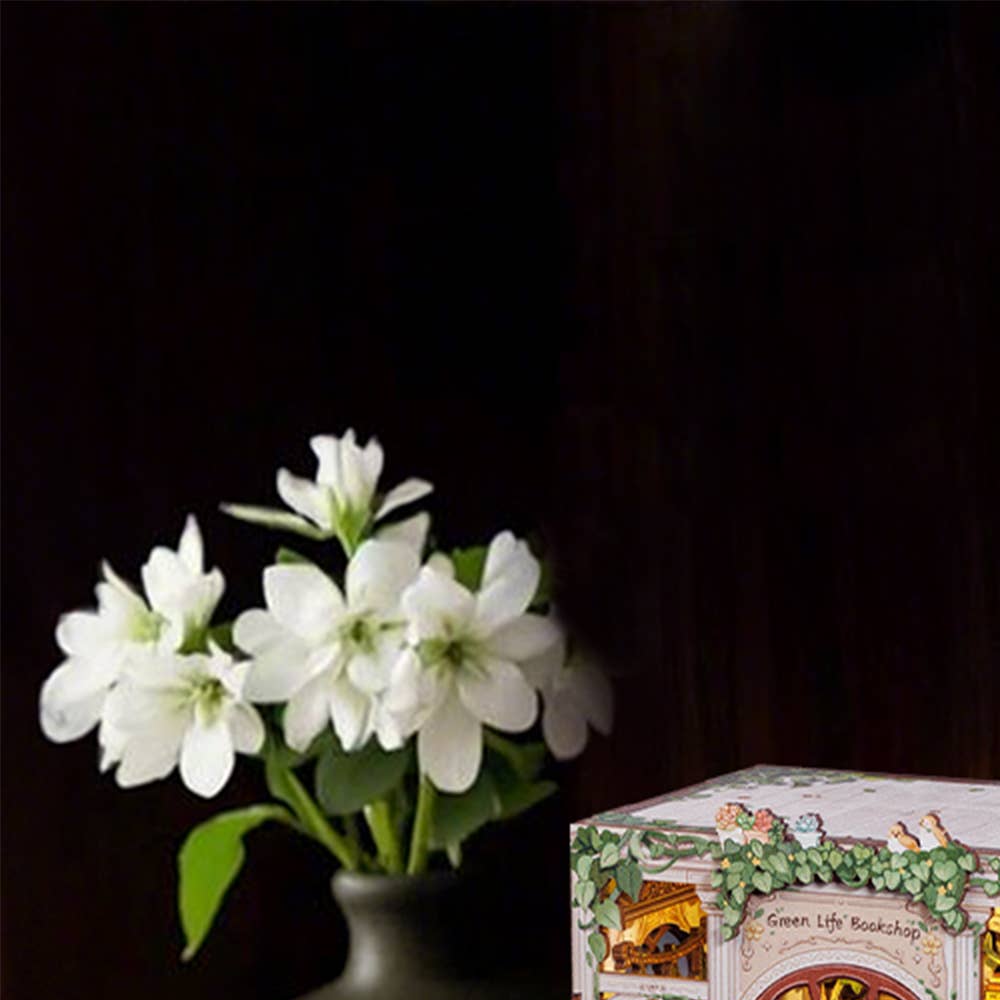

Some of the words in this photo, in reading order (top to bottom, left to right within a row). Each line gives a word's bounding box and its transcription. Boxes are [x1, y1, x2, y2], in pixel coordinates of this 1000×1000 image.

[767, 912, 811, 929] Green
[817, 911, 843, 934] Life
[851, 916, 921, 946] Bookshop
